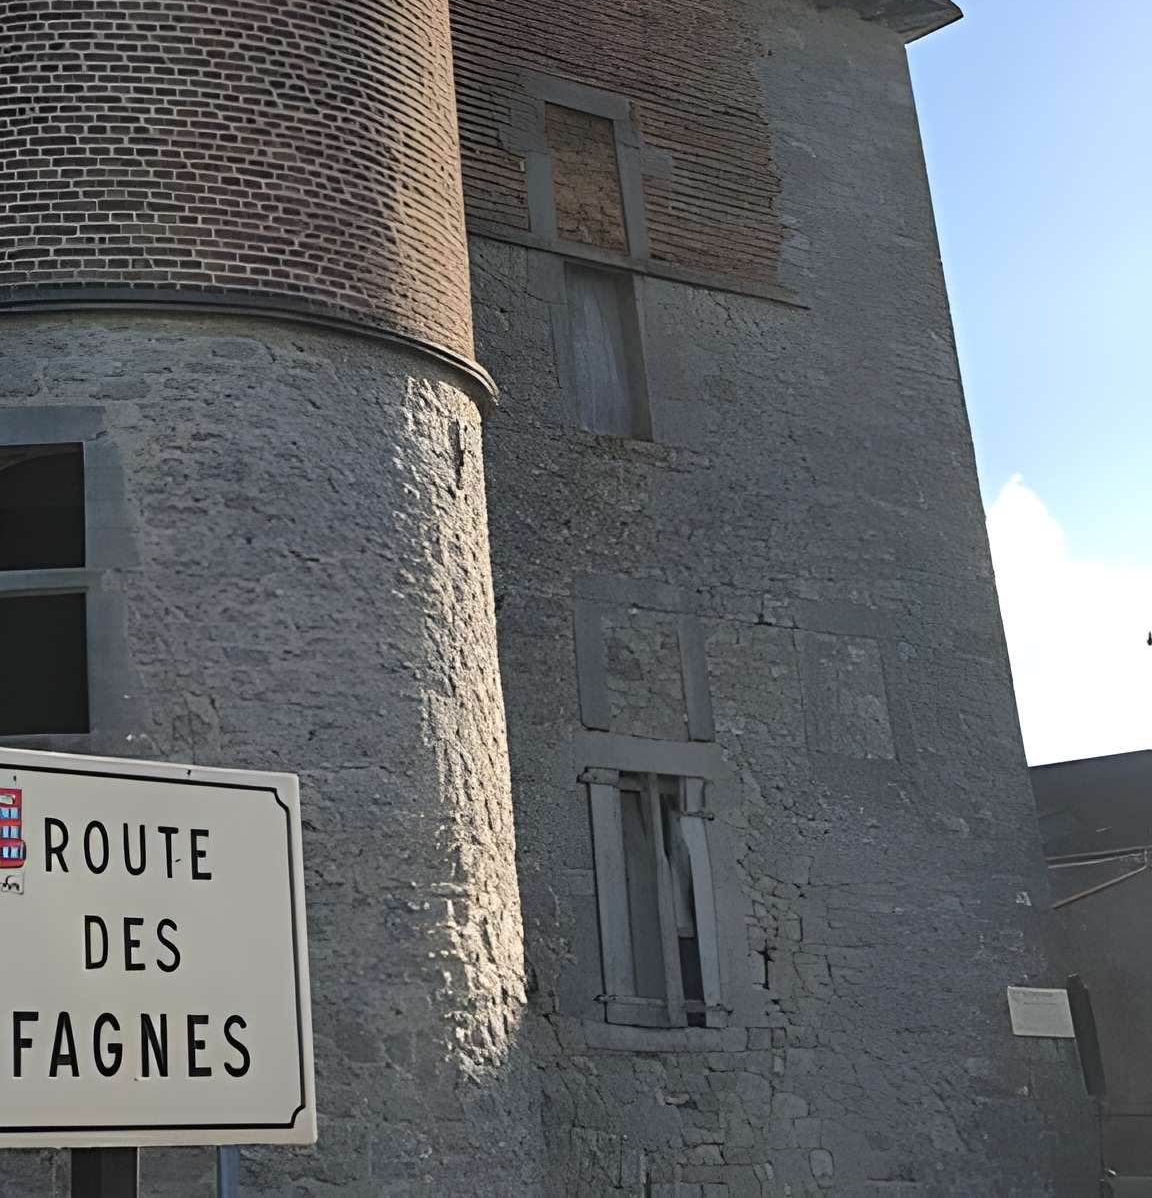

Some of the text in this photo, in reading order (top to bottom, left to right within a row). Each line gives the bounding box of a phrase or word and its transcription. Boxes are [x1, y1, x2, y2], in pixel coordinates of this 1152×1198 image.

[44, 817, 212, 881] ROUTE
[84, 914, 181, 973] DES
[12, 1010, 251, 1078] FAGNES
